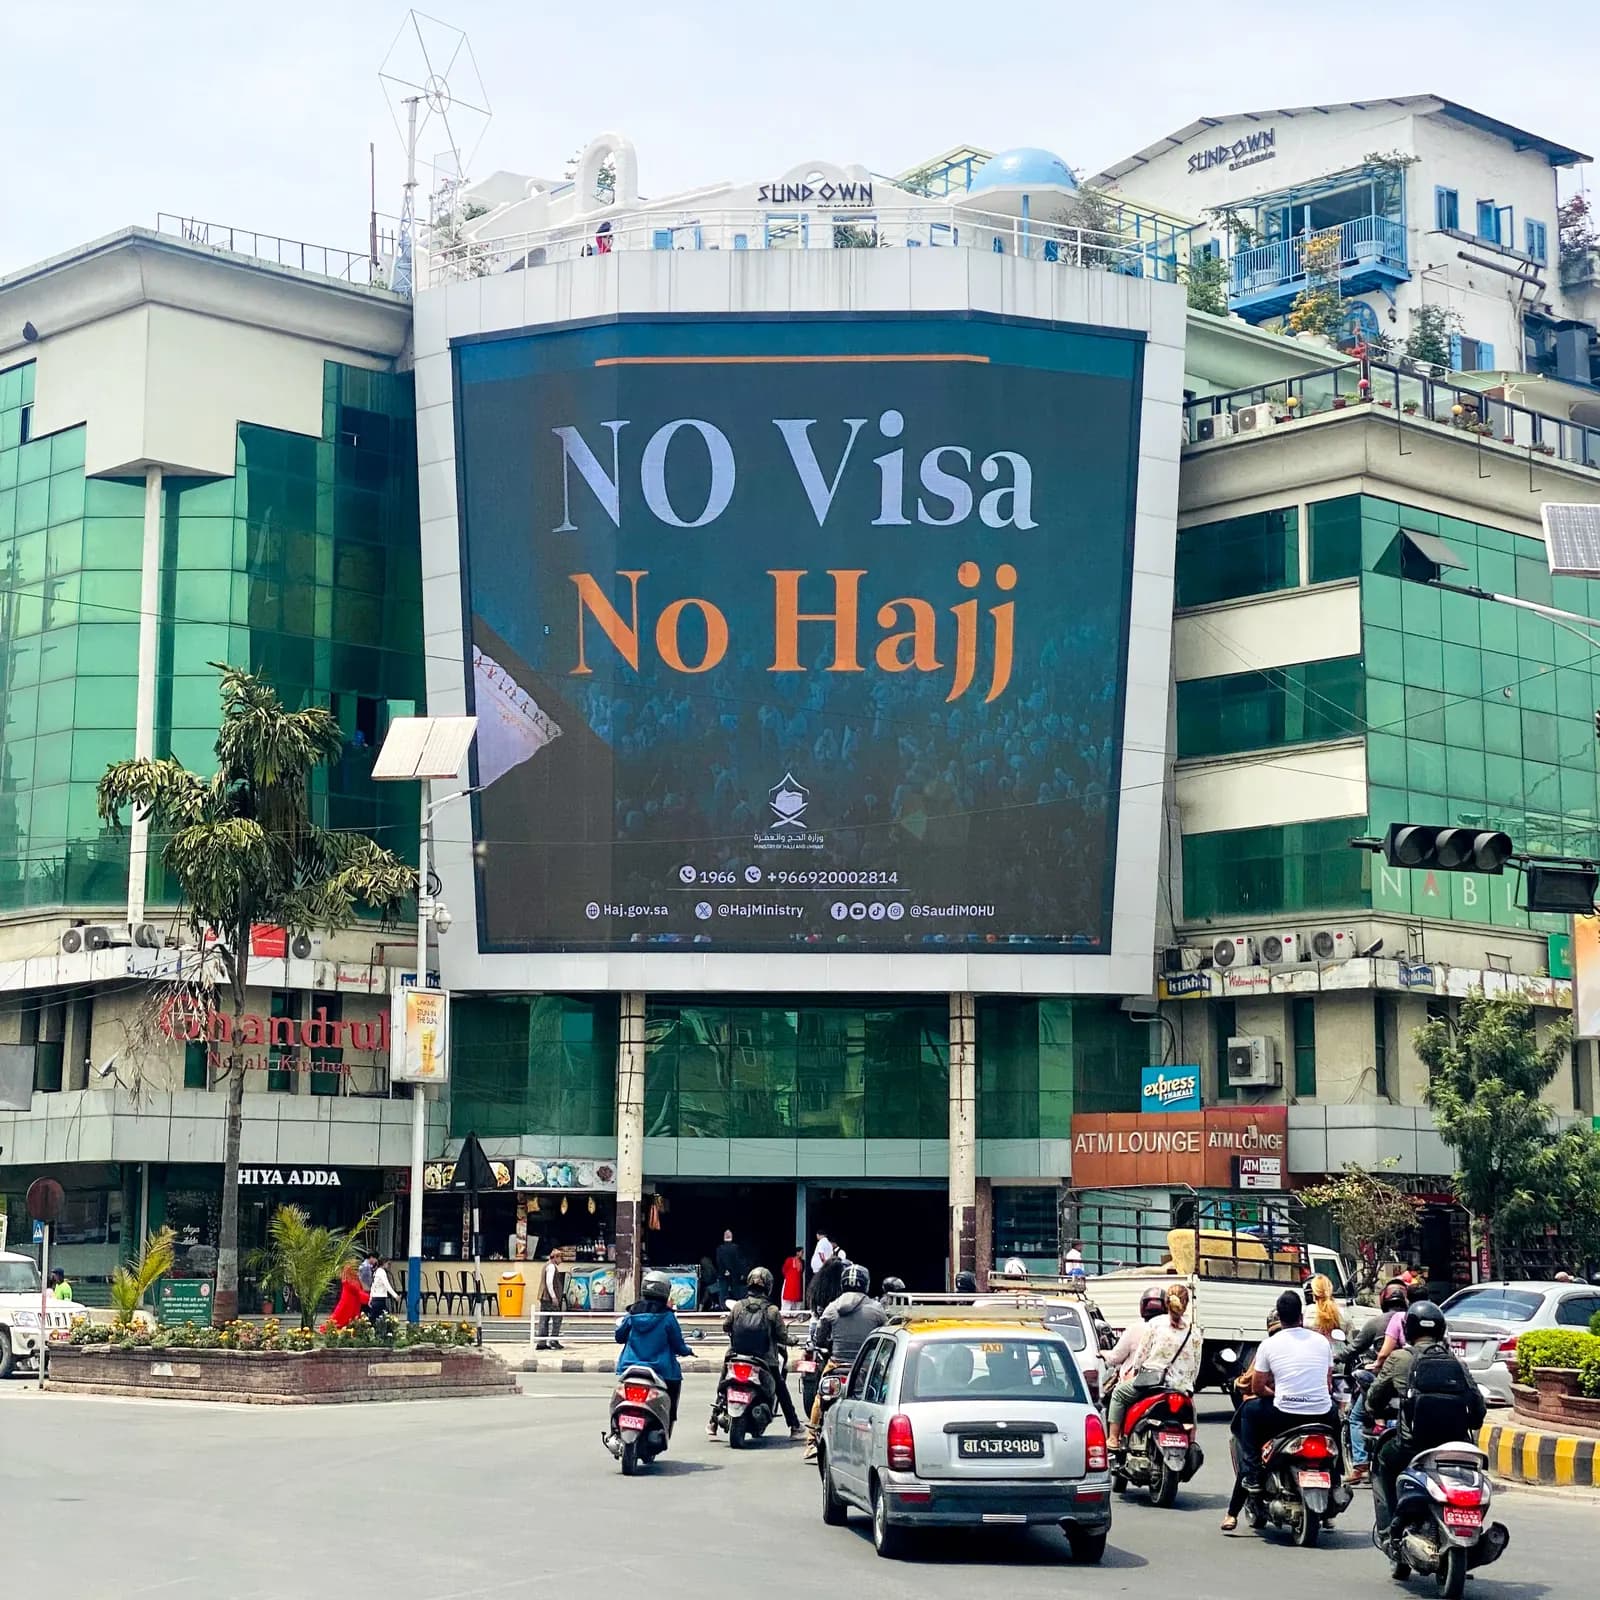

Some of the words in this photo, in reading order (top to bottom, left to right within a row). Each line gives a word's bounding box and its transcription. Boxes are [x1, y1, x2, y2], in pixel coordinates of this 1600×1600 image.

[1188, 128, 1275, 174] SUNDOWN
[757, 182, 874, 203] SUNDOWN
[552, 418, 736, 533] NO
[772, 409, 1039, 531] Visa
[568, 570, 729, 674] No
[766, 561, 1018, 704] Hajj
[700, 870, 737, 885] 1966
[767, 870, 898, 885] +966920002814
[1380, 866, 1512, 912] NABI
[603, 903, 669, 918] Haj.gov.sa
[718, 903, 804, 919] @HajMinistry
[910, 904, 995, 918] @SaudiMOHU
[209, 1053, 269, 1070] Neali
[1143, 1073, 1196, 1101] express
[1163, 1088, 1194, 1101] THAKALI
[1074, 1132, 1113, 1153] ATM
[1118, 1131, 1201, 1153] LOUNGE
[1208, 1131, 1233, 1148] ATM
[1242, 1159, 1259, 1171] ATM
[238, 1170, 284, 1185] HIYA
[288, 1171, 342, 1186] ADDA
